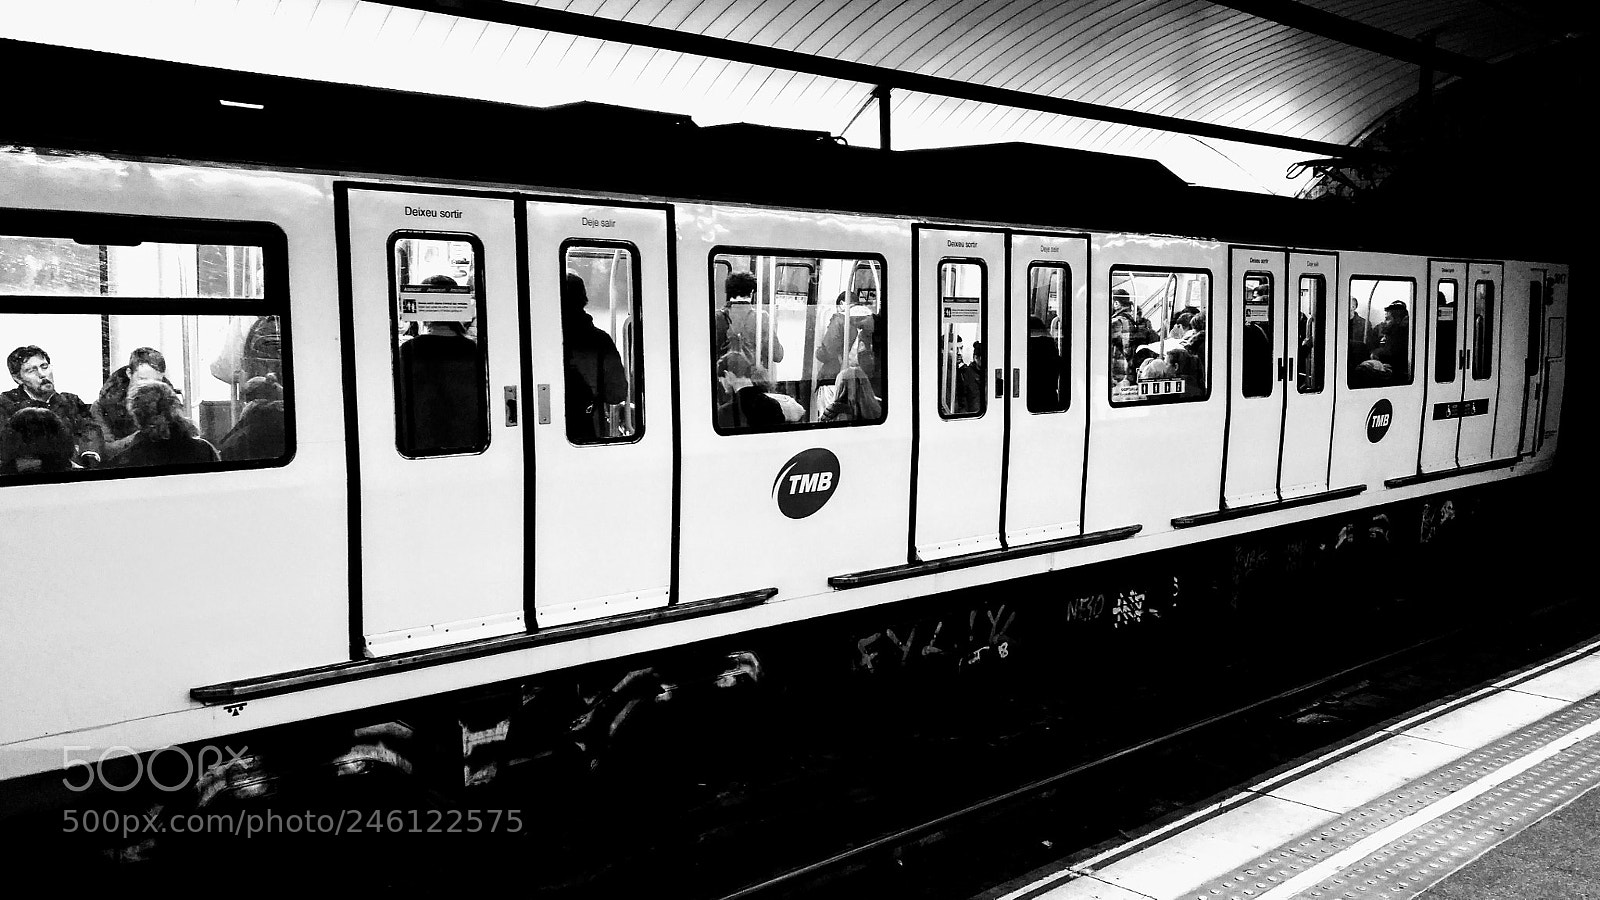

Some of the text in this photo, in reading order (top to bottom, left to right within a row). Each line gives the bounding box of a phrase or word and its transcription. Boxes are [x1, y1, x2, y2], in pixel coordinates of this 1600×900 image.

[404, 206, 463, 219] Deixeu sortir
[581, 217, 616, 228] Deje salir
[947, 239, 965, 248] Deixeu
[1372, 414, 1390, 428] TMB
[789, 471, 833, 495] TMB
